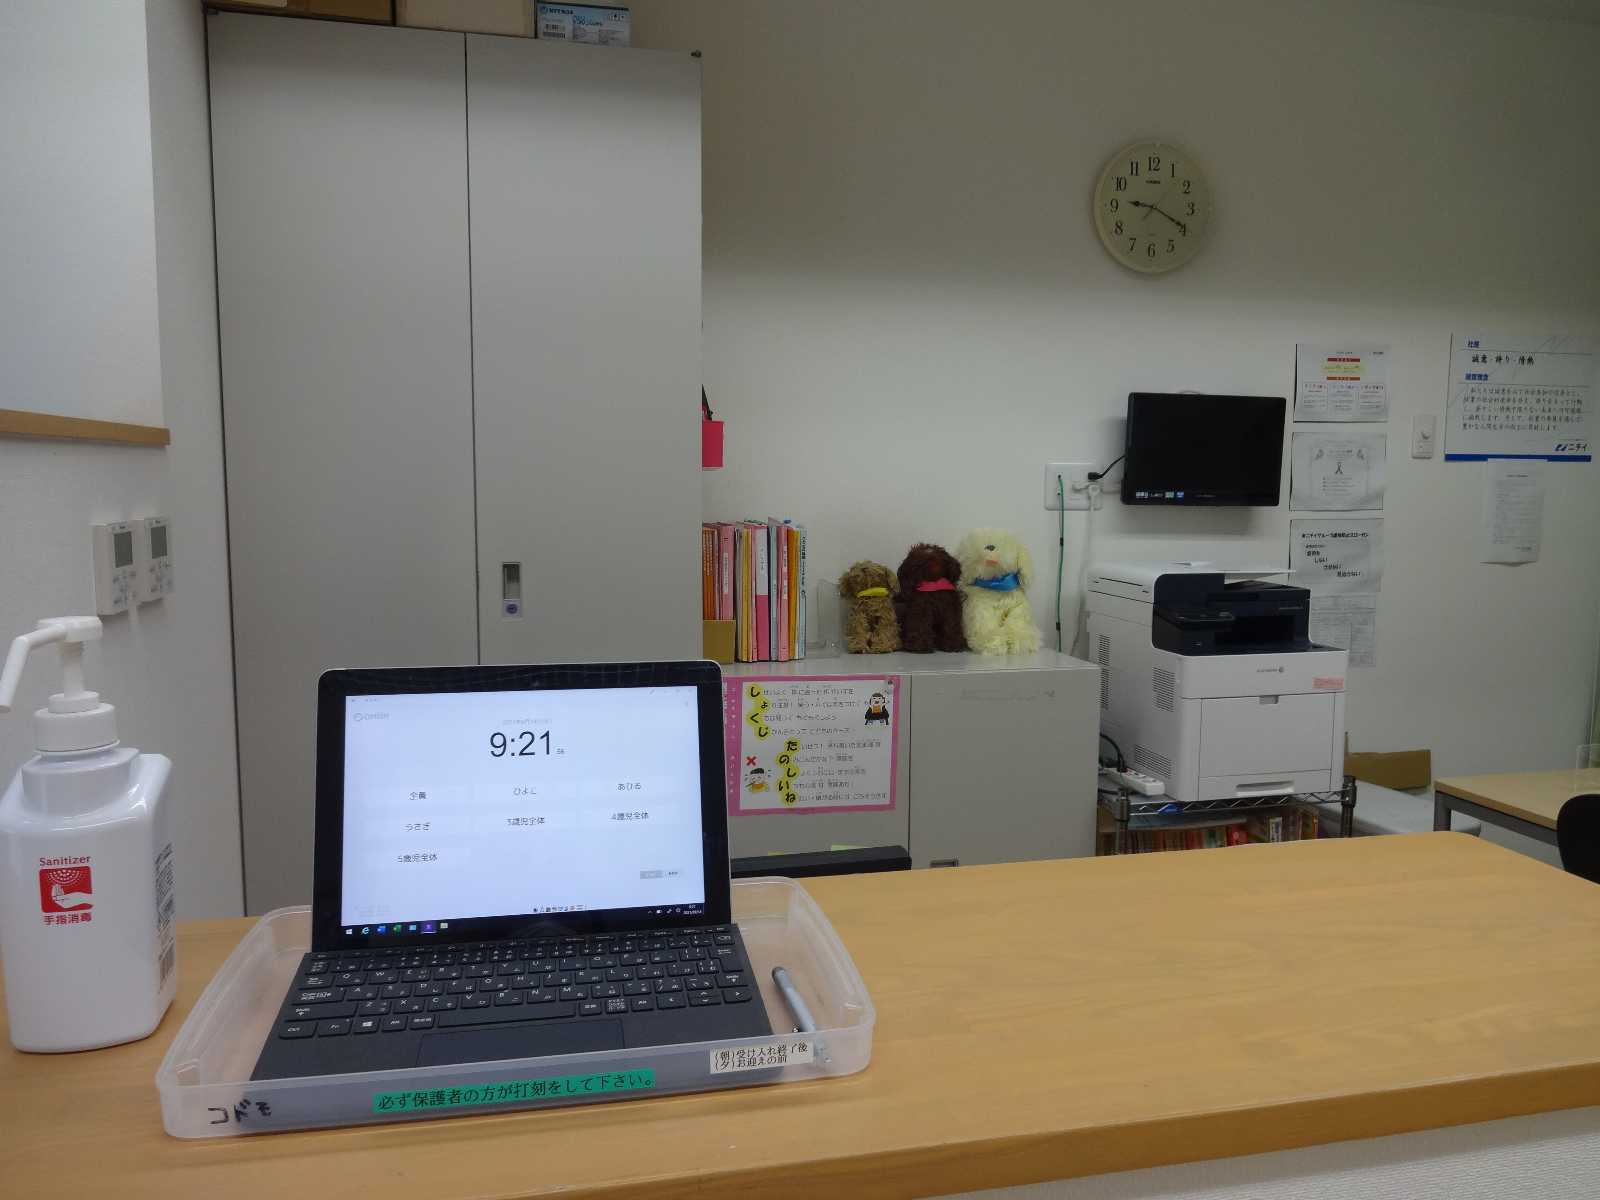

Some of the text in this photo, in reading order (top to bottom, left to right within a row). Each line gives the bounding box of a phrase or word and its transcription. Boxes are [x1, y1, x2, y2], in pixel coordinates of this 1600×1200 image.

[1130, 160, 1139, 176] 11
[1147, 156, 1161, 172] 12
[1170, 163, 1175, 178] 1
[1114, 176, 1127, 192] 10
[1182, 180, 1191, 194] 2
[1110, 198, 1119, 213] 9
[1186, 202, 1195, 216] 3
[1114, 220, 1124, 235] 8
[1178, 223, 1187, 237] 4
[1128, 237, 1137, 252] 7
[1147, 243, 1156, 257] 6
[1166, 239, 1175, 253] 5
[488, 730, 551, 757] 9:21
[513, 786, 537, 796] ひよこ
[616, 782, 642, 791] あひる
[404, 822, 431, 832] うさぎ
[39, 855, 91, 867] Sanitizer
[43, 912, 92, 926] 手指消毒
[715, 1042, 808, 1061] (朝)受け入れ終了後
[715, 1055, 787, 1071] (夕)お迎えの前
[377, 1073, 654, 1111] 必ず保護者の方が打刻をして下さい。
[207, 1098, 272, 1125] コドモ
